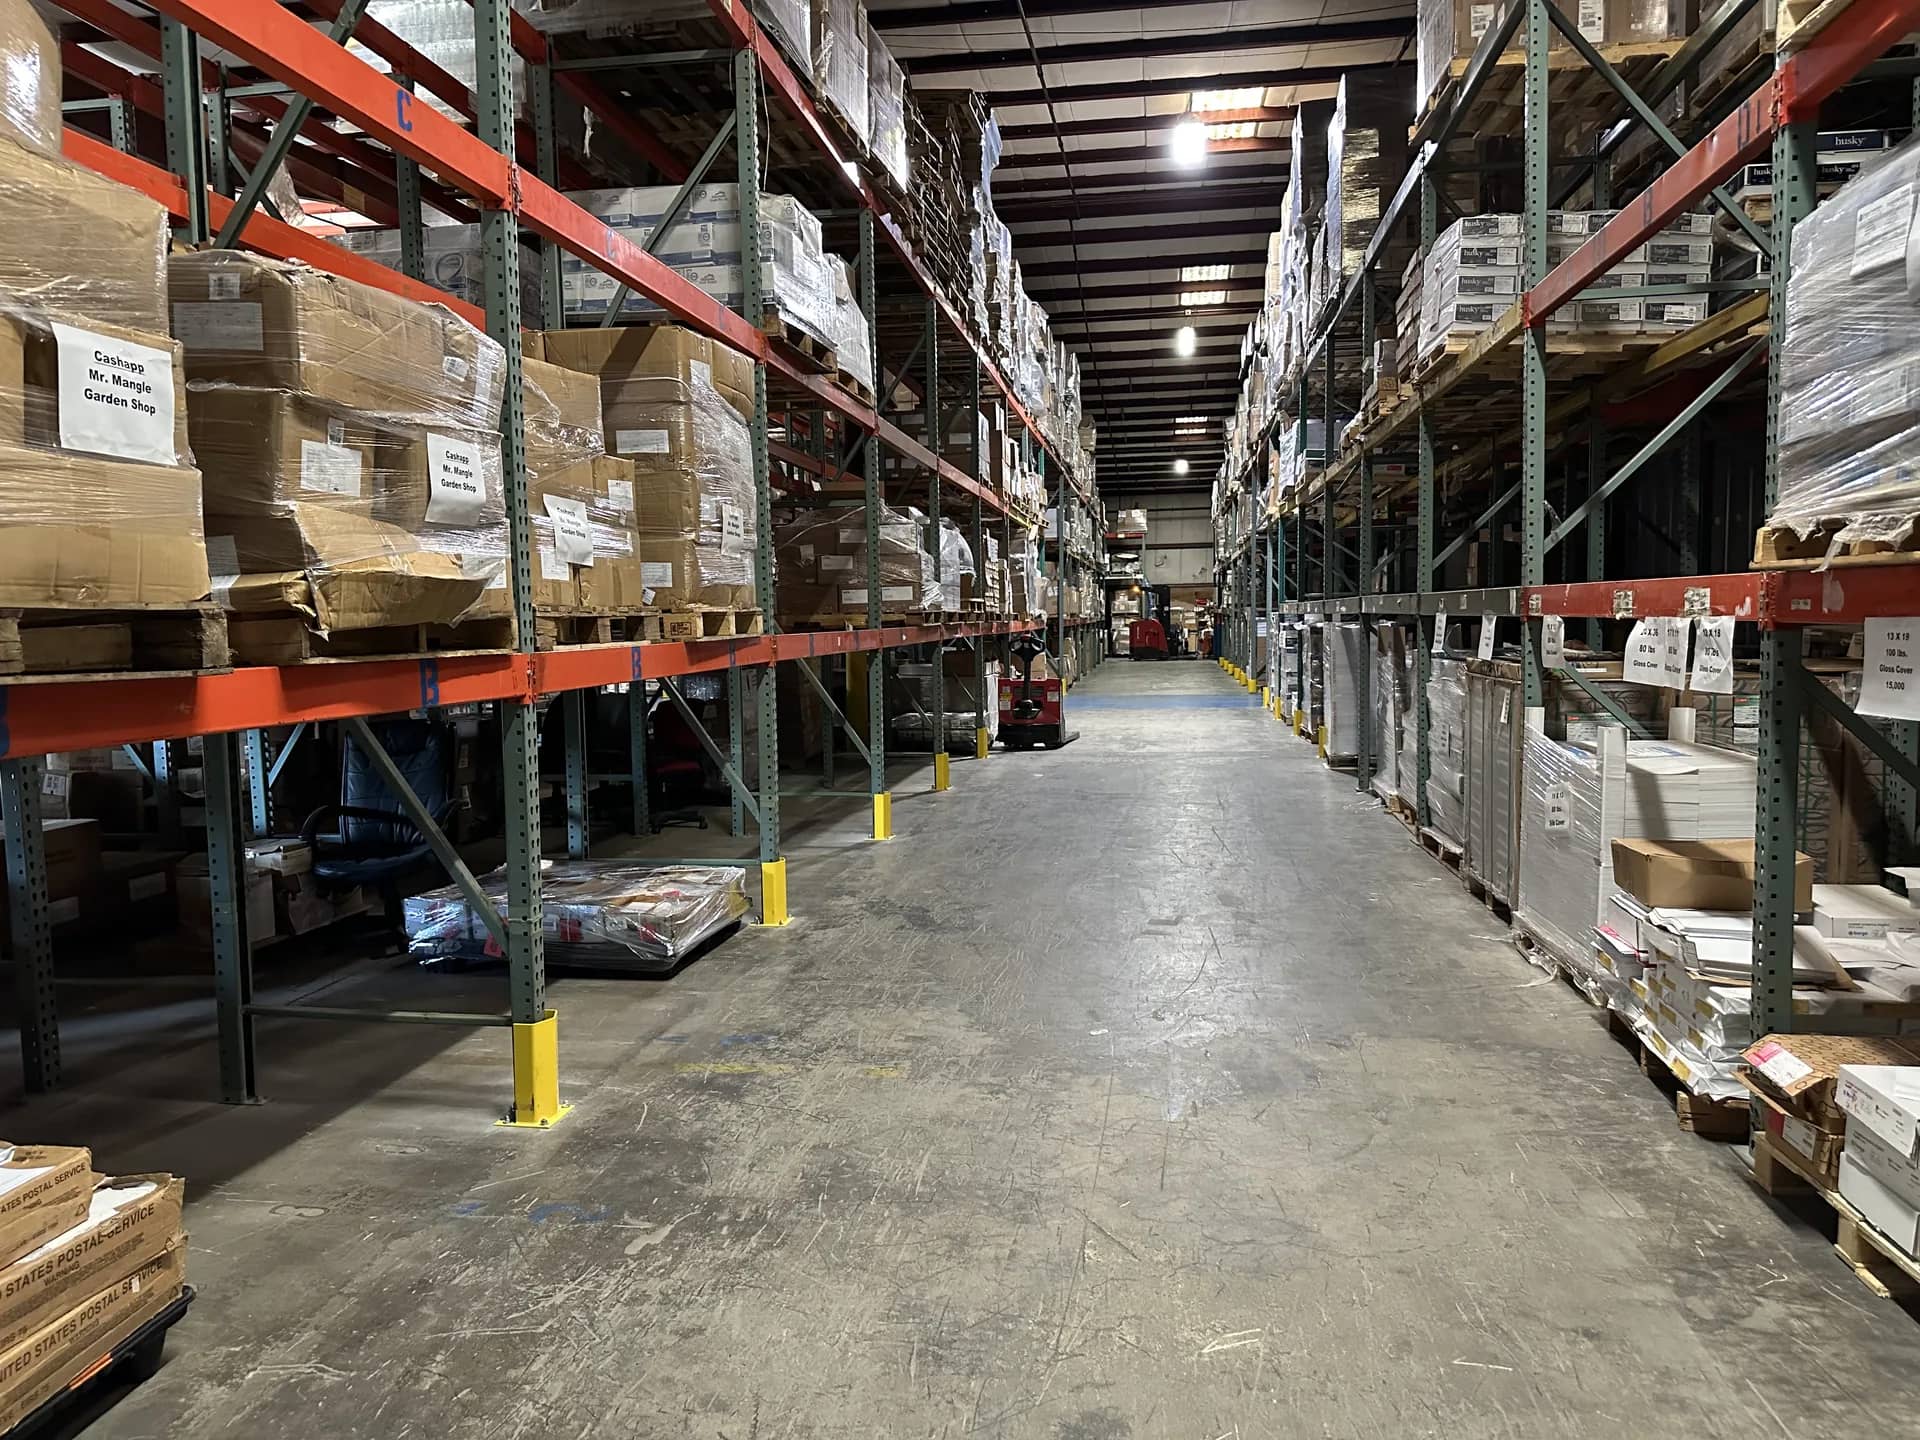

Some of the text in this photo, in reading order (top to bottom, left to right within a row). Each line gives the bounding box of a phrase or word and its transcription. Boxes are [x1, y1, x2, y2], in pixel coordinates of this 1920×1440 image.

[397, 89, 412, 131] C
[1835, 136, 1864, 146] husky
[94, 350, 145, 374] Cashapp
[89, 368, 152, 394] Mr. Mangle
[84, 388, 156, 416] Garden Shop
[445, 450, 469, 465] Cashapp
[454, 466, 473, 479] Mangle
[441, 478, 477, 493] Garden Shop
[1895, 632, 1901, 641] X
[1885, 648, 1896, 657] 100
[1879, 663, 1913, 674] Gloss Cover
[420, 660, 439, 706] B
[22, 1181, 54, 1202] POSTAL
[54, 1162, 86, 1185] SERVICE
[6, 1261, 54, 1297] STATES
[57, 1231, 104, 1266] POSTAL
[34, 1319, 77, 1357] STATES
[79, 1291, 120, 1326] POSTAL
